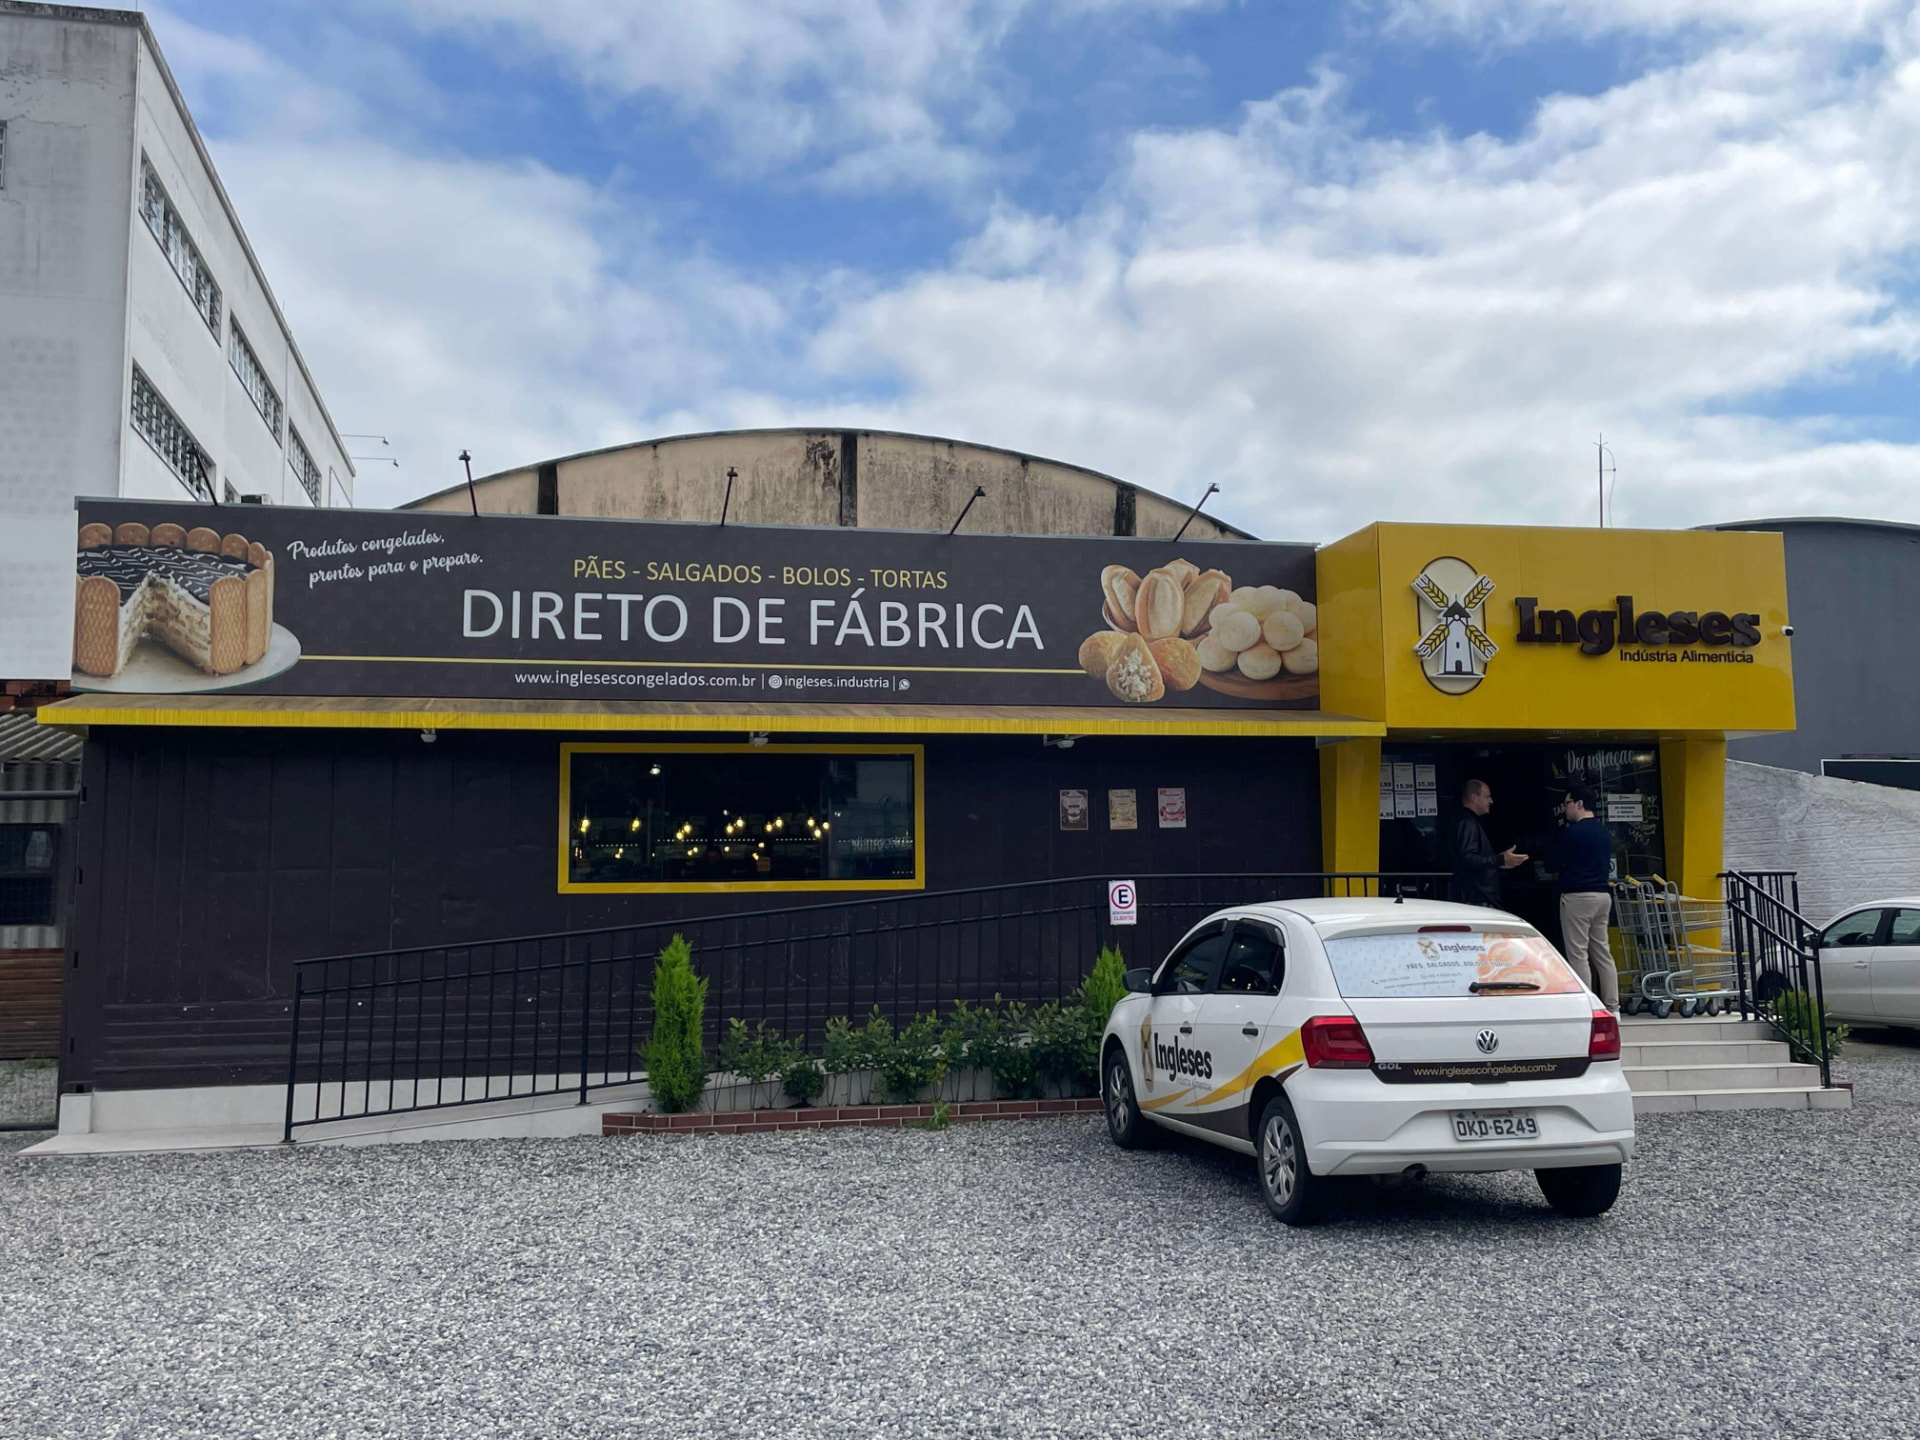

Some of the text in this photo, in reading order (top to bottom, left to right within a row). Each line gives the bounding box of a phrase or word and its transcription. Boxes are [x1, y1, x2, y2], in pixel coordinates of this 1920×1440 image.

[287, 529, 445, 560] Produtos congelados,
[309, 553, 484, 589] prontos para o preparo.
[573, 556, 626, 579] PÃES
[647, 562, 762, 584] SALGADOS
[783, 567, 851, 586] BOLOS
[870, 569, 948, 589] TORTAS
[463, 588, 1044, 650] DIRETO DE FÁBRICA
[1515, 595, 1761, 656] Ingleses
[1620, 649, 1677, 663] Indústria
[515, 670, 889, 690] www.inglesescongelados.com.br ingleses.industria
[1118, 889, 1129, 904] E
[1438, 943, 1486, 953] Ingleses
[1154, 1032, 1212, 1081] Ingleses
[1378, 1062, 1402, 1070] GOL
[1413, 1063, 1557, 1077] www.inglesescongelados.com.br
